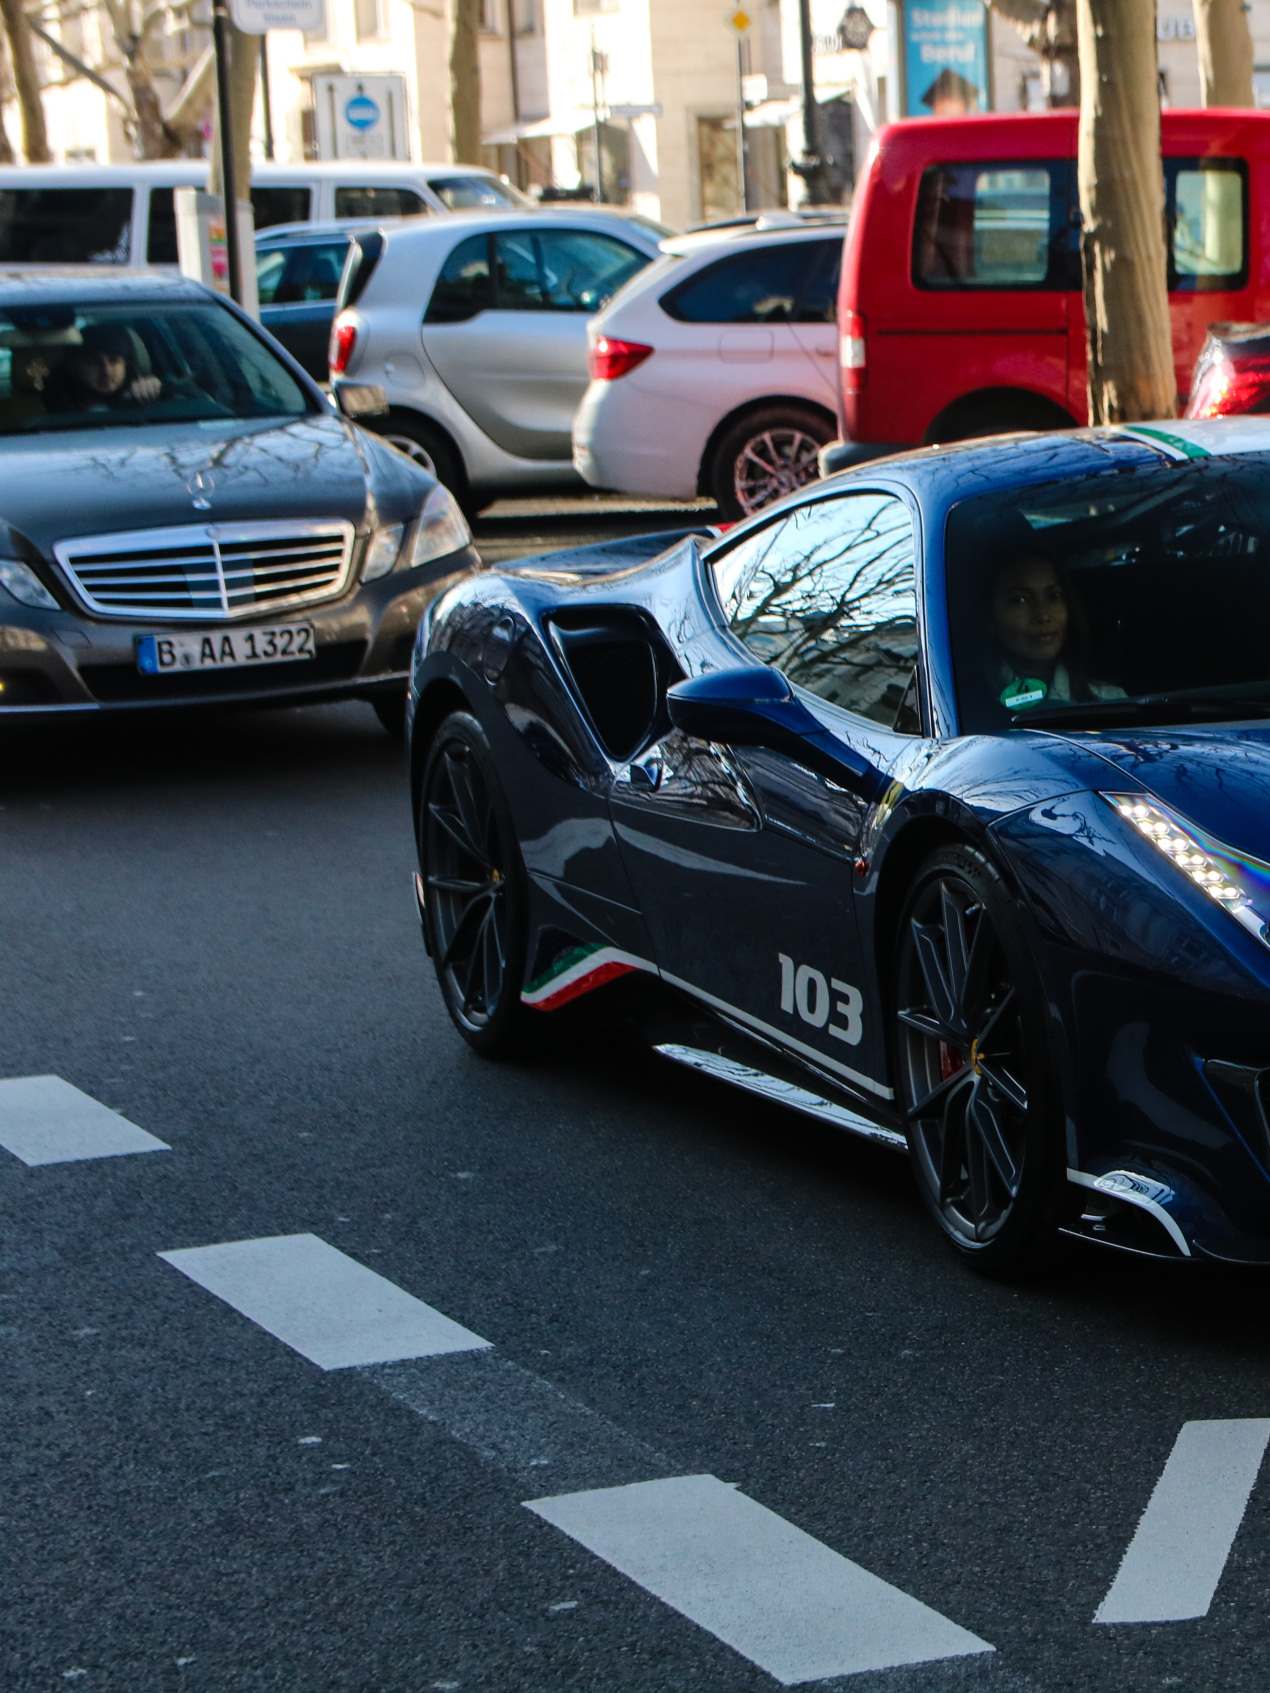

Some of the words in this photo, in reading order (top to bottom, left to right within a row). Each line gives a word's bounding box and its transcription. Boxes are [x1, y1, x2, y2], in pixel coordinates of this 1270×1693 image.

[157, 640, 177, 668] B
[200, 636, 237, 664] AA
[244, 628, 311, 660] 1322
[778, 952, 863, 1046] 103
